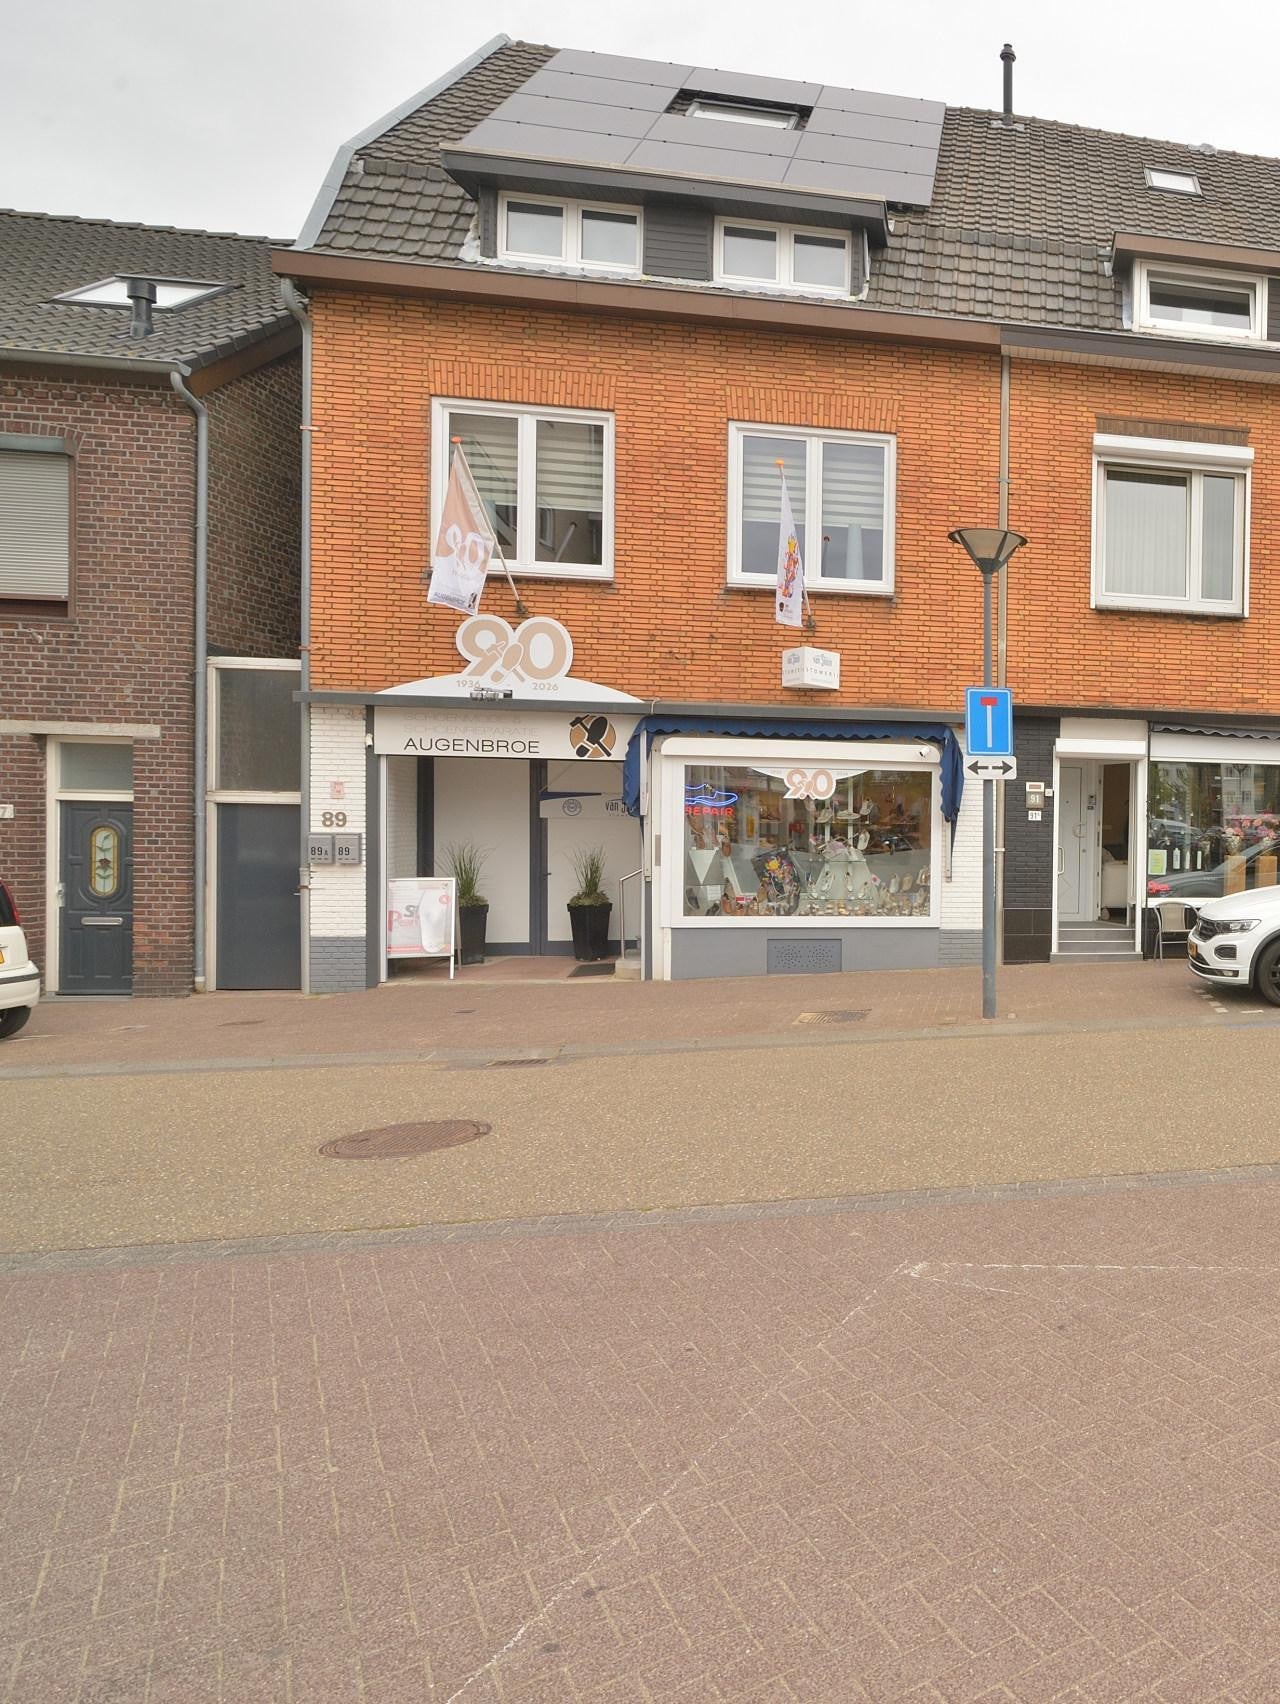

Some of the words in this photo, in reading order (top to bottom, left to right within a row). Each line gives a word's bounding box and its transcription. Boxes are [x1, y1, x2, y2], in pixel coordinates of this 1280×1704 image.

[460, 619, 568, 680] 90
[456, 680, 481, 689] 1936
[532, 683, 559, 692] 2026
[403, 737, 541, 754] AUGENBROE
[1030, 794, 1040, 803] 91
[321, 811, 347, 828] 89
[338, 846, 350, 856] 89
